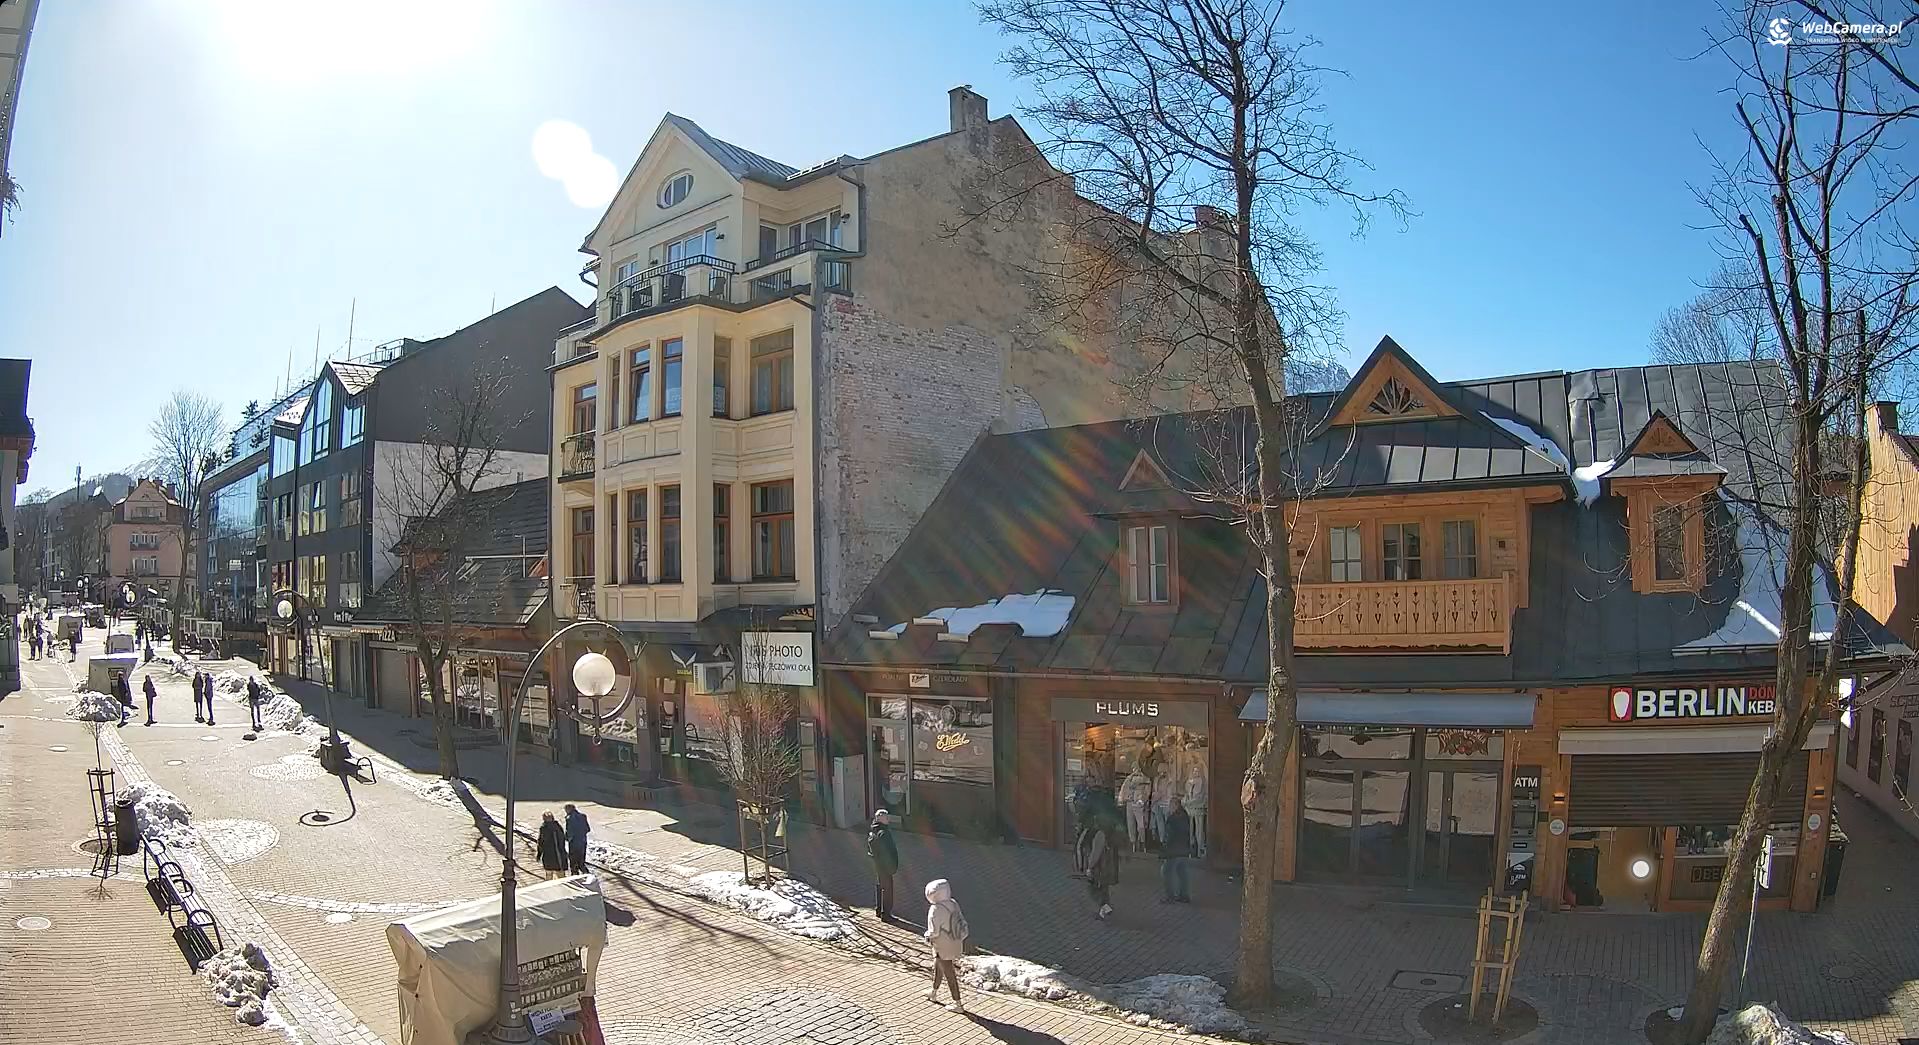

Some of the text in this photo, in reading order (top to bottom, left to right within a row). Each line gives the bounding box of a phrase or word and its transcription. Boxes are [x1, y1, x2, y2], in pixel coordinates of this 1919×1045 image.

[769, 645, 803, 657] PHOTO
[798, 664, 811, 672] OKA
[1749, 685, 1777, 700] DÖN
[1096, 701, 1159, 716] PLUMS
[1636, 687, 1745, 718] BERLIN
[1514, 777, 1538, 788] ATM
